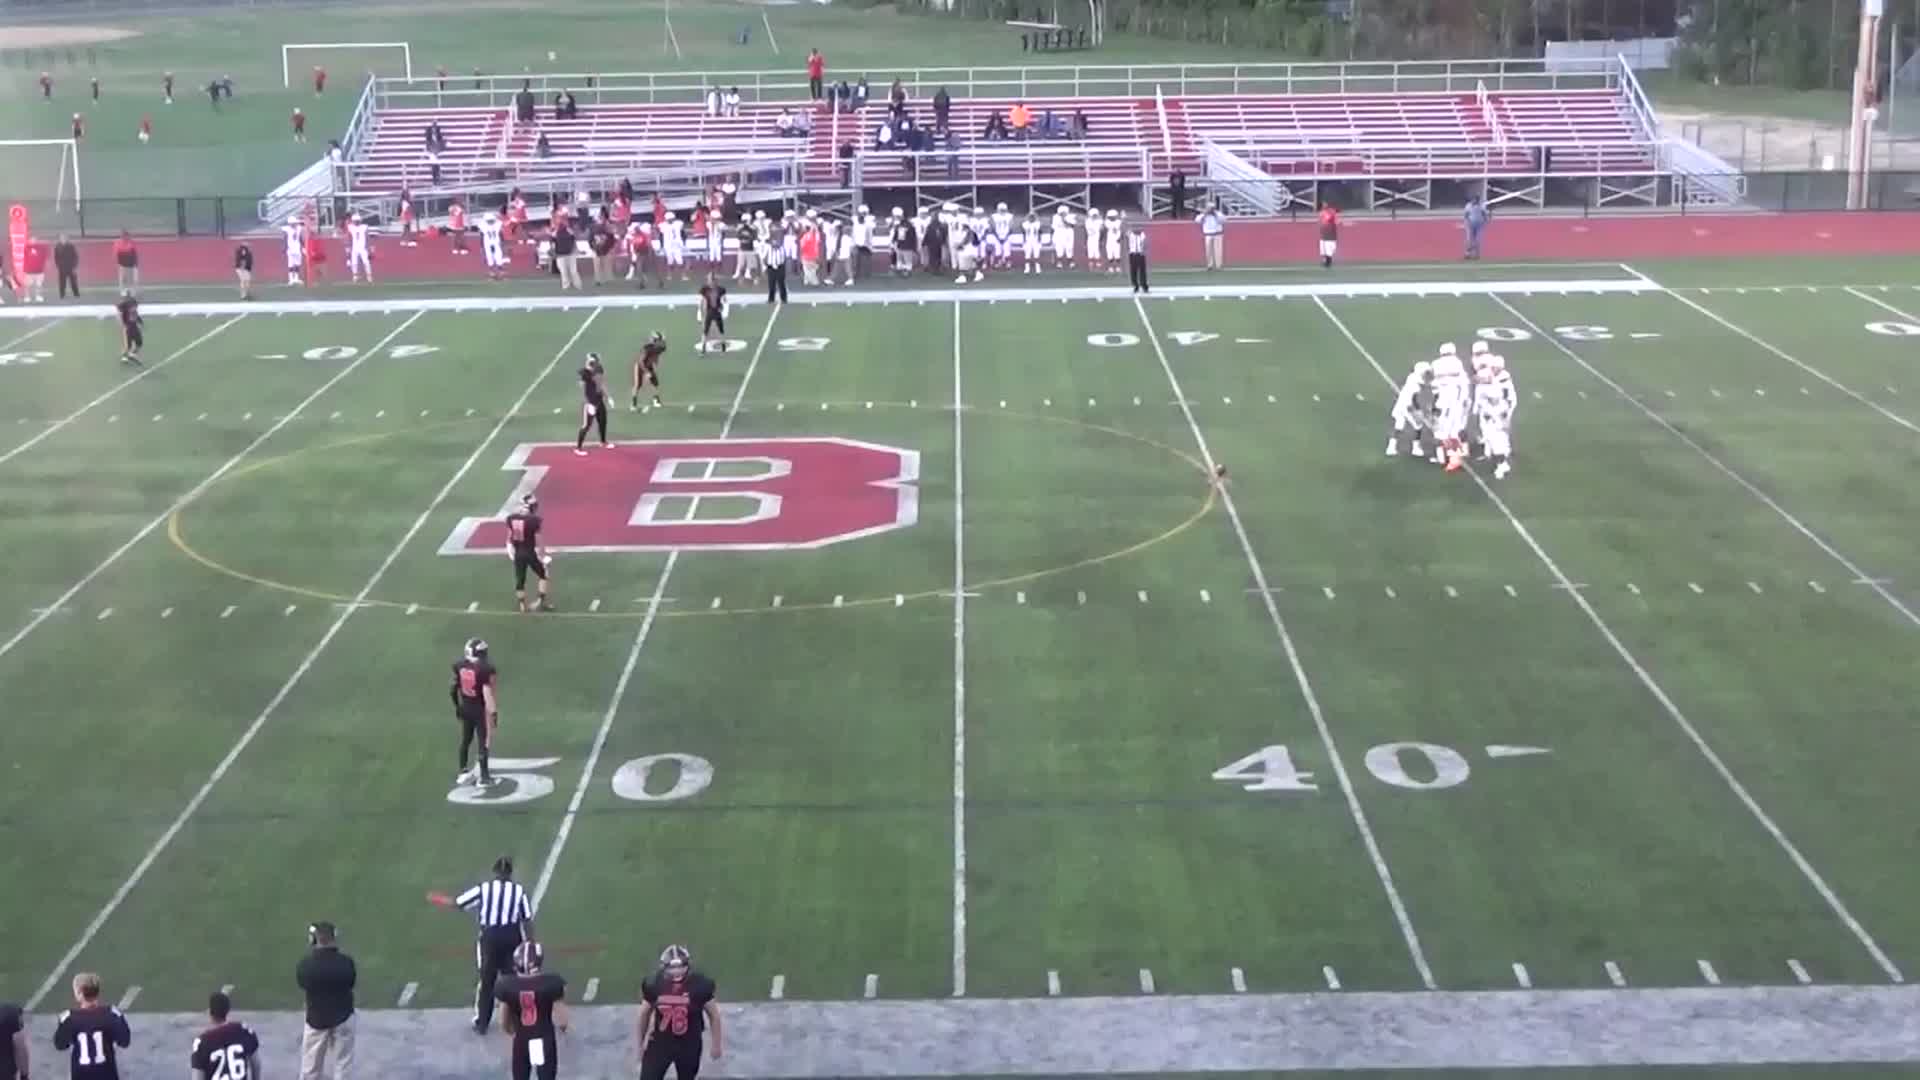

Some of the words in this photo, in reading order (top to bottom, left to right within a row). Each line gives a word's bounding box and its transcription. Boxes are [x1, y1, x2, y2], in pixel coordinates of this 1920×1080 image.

[440, 437, 920, 554] B
[447, 752, 714, 804] 50
[1211, 741, 1470, 790] 40
[76, 1030, 107, 1065] 11
[209, 1044, 246, 1080] 26
